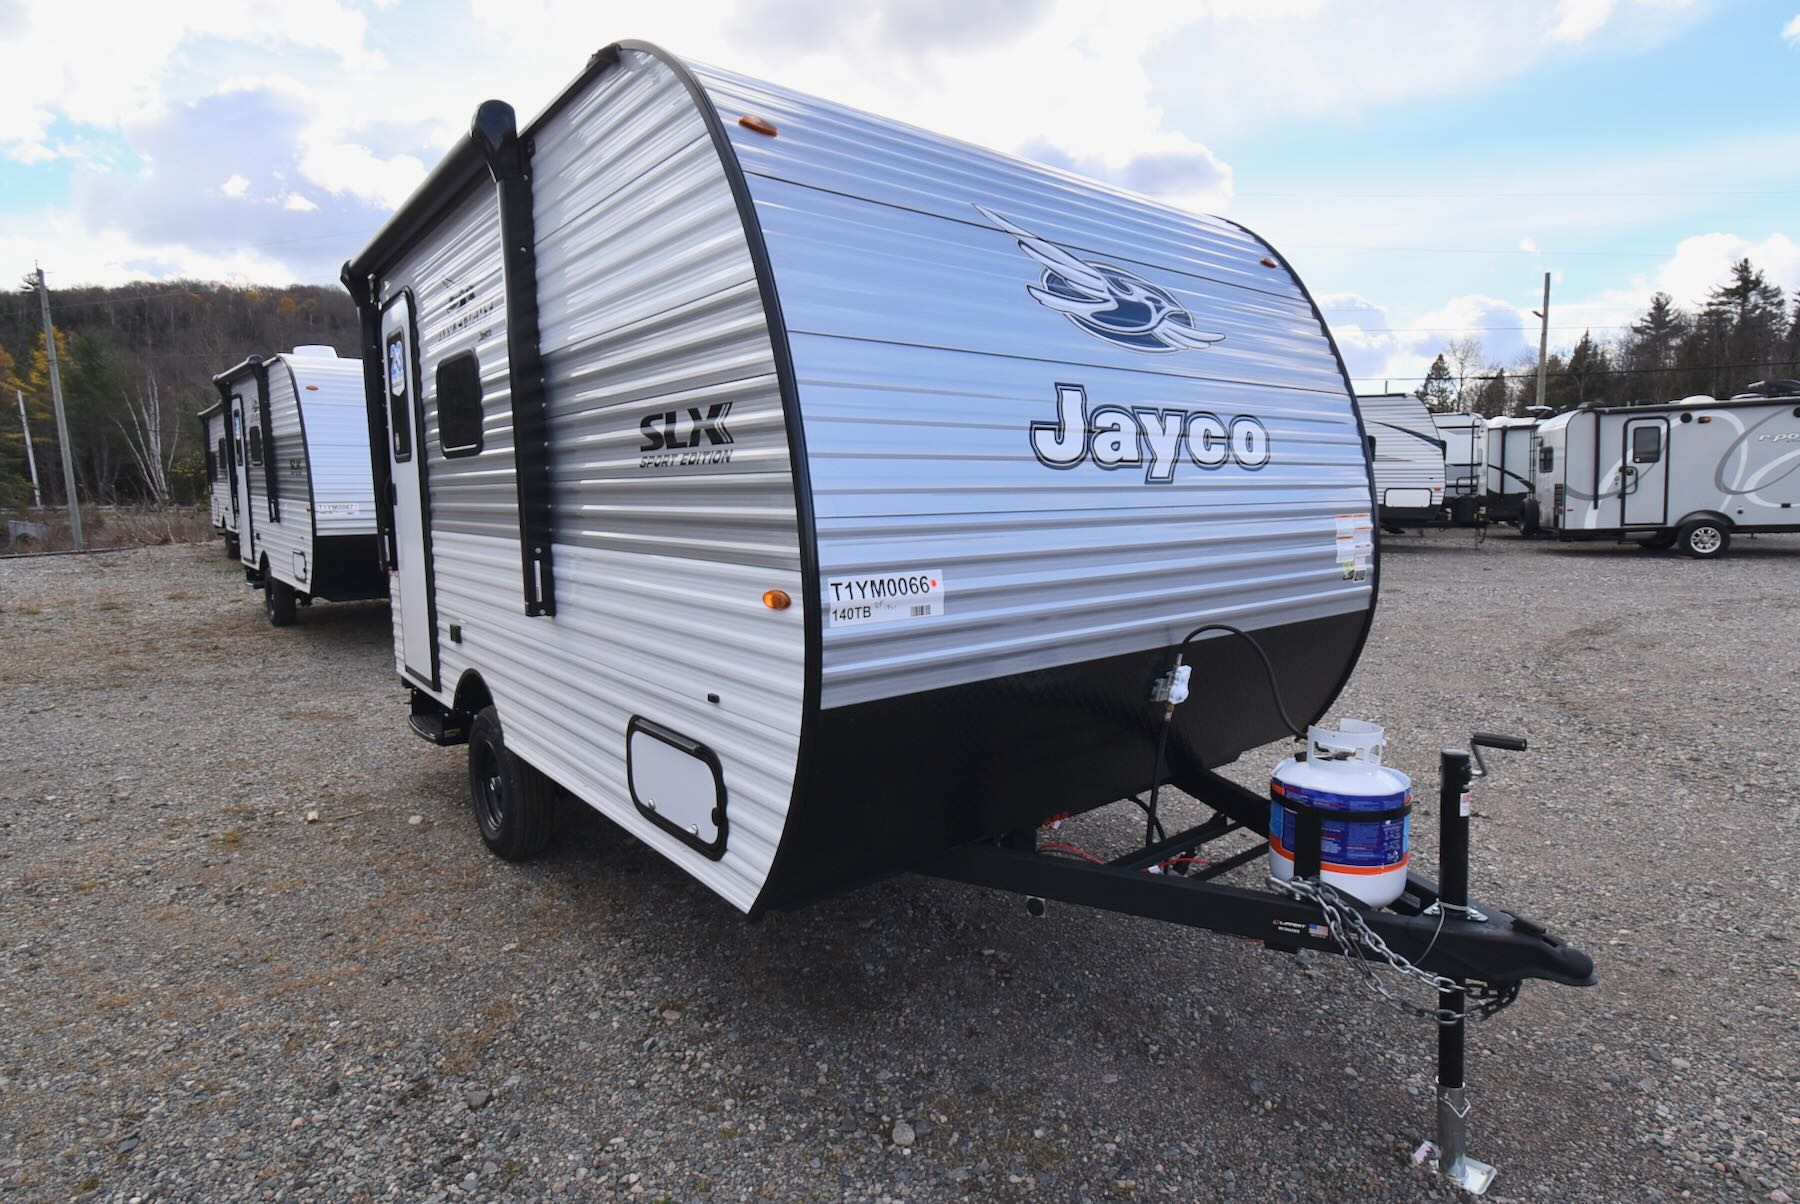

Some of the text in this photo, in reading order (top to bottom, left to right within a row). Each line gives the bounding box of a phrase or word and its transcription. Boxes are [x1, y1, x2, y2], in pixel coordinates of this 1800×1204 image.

[640, 401, 735, 451] SLX
[1030, 382, 1270, 485] Jayco
[640, 449, 733, 468] SPORT EDITION
[831, 576, 930, 601] T1YM0066
[832, 606, 871, 621] 140TB
